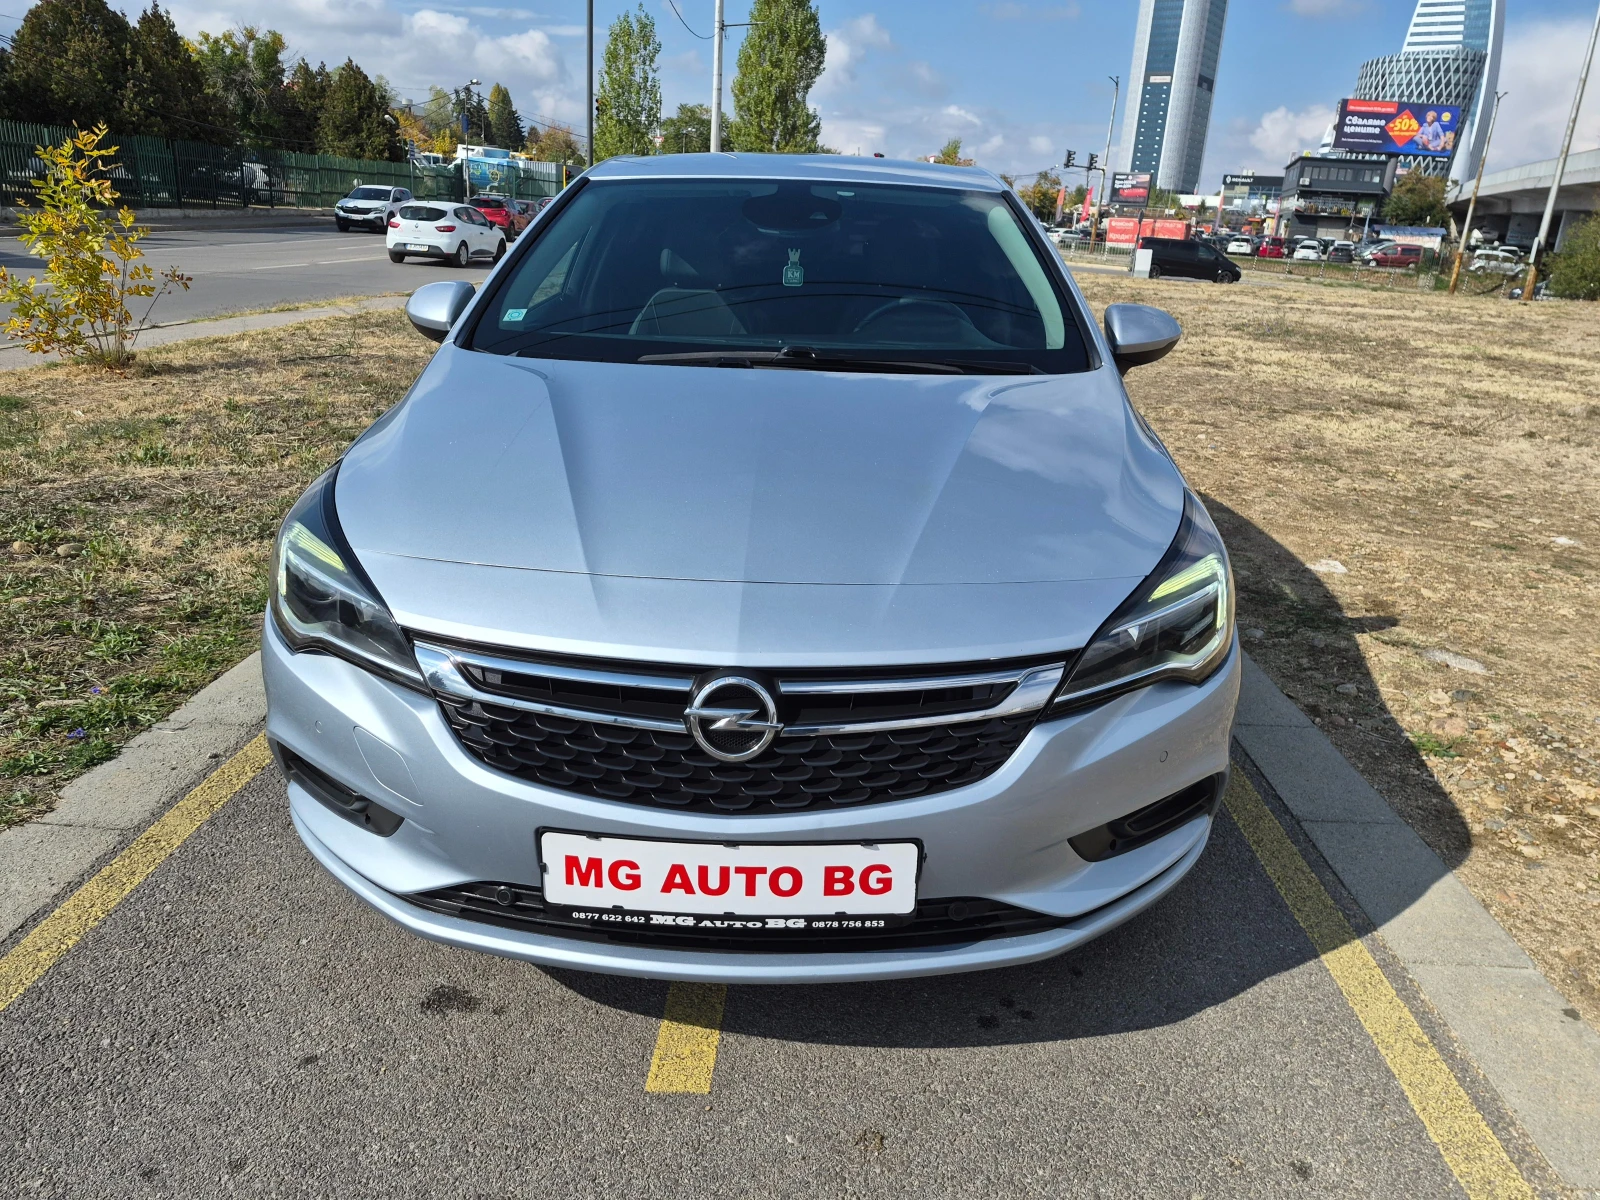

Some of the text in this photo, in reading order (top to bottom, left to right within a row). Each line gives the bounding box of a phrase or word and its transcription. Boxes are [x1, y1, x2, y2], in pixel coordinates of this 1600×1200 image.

[1345, 115, 1386, 126] Сваляме
[1389, 118, 1419, 131] -50%
[1343, 125, 1381, 134] цените
[564, 854, 893, 897] MG AUTO BG
[572, 911, 885, 929] 0877 622 642 MG AUTO BG 0878 756 853
